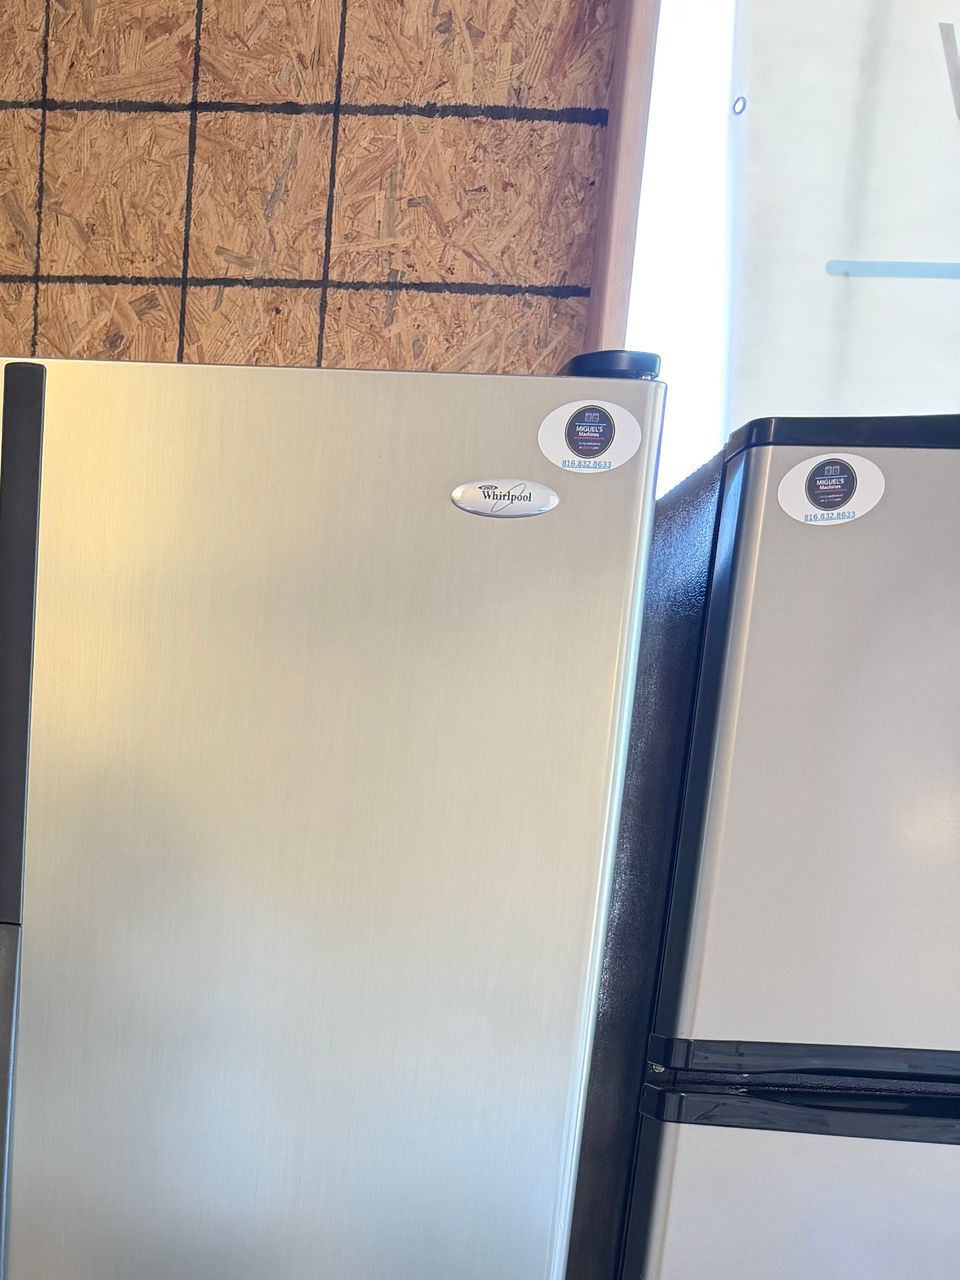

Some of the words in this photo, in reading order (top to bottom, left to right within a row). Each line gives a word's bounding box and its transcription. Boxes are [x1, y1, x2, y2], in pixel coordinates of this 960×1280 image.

[575, 425, 603, 433] MIGUEL'S
[561, 460, 612, 469] 816.832.8633
[816, 478, 845, 486] MIGUEL'S
[482, 490, 532, 504] Whirlpool
[804, 511, 856, 521] 816.832.8633
